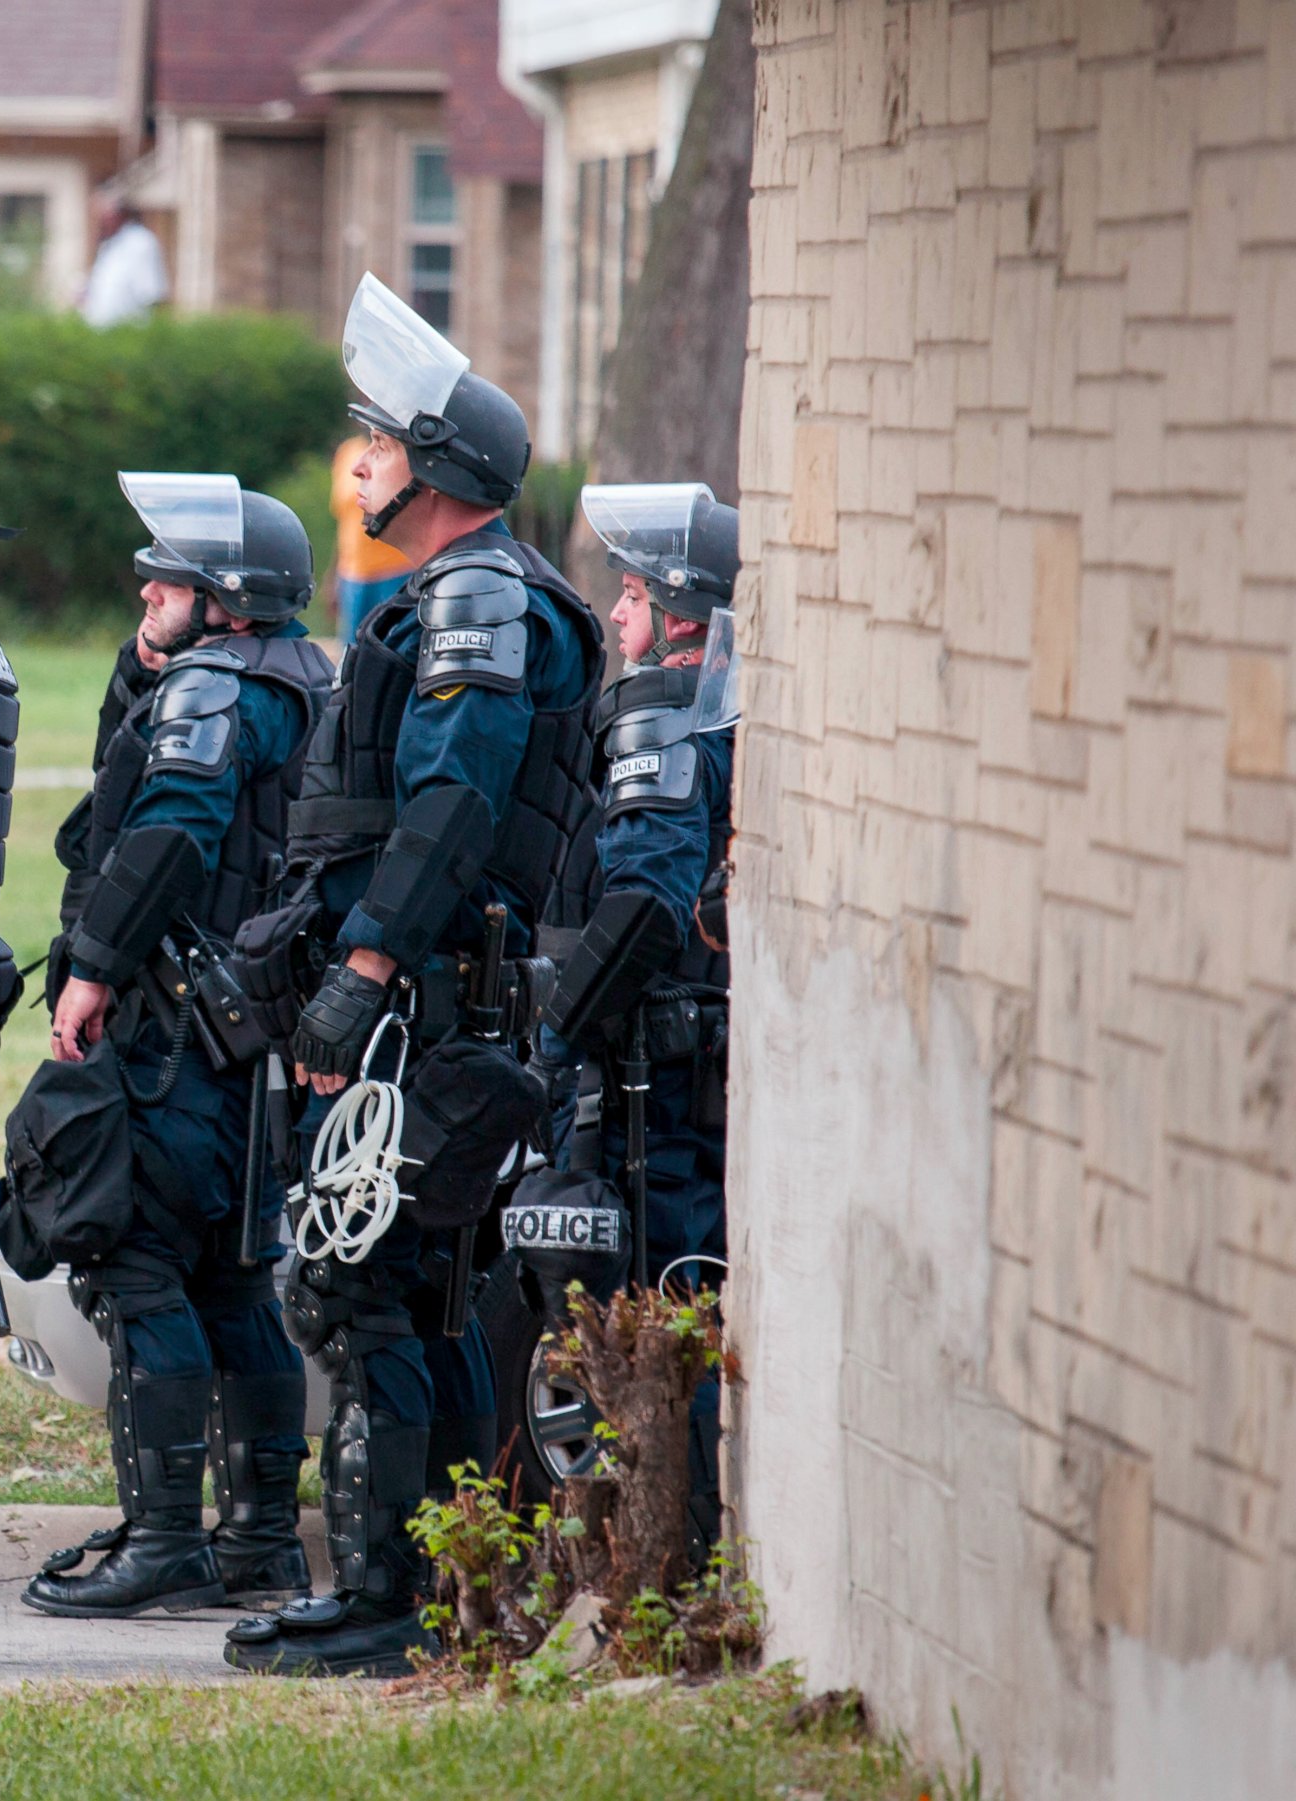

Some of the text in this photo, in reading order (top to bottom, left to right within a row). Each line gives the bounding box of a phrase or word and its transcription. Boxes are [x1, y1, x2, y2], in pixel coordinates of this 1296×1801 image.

[438, 633, 489, 647] POLICE
[613, 758, 656, 778] POLICE
[505, 1210, 610, 1244] POLICE
